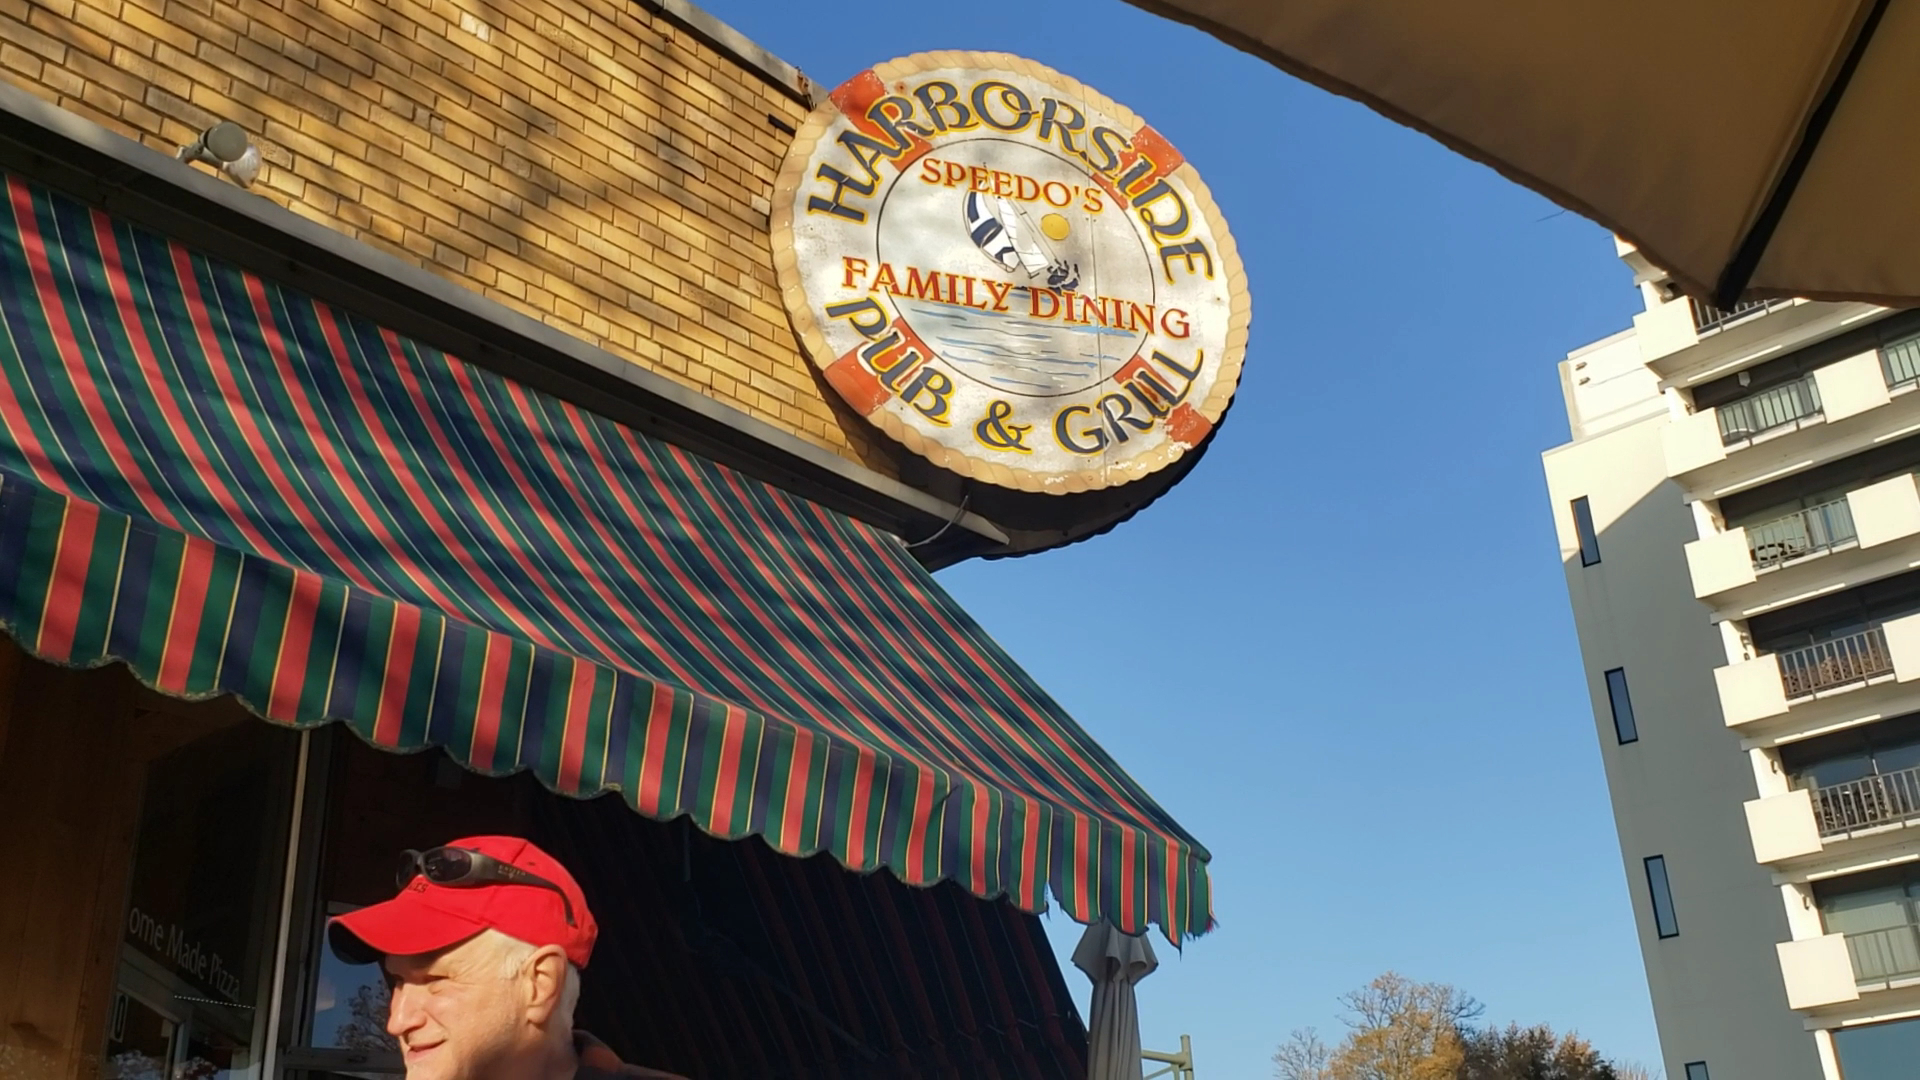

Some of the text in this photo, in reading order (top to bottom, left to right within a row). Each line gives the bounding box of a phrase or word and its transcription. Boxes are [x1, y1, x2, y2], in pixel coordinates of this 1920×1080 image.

[807, 80, 1214, 285] HARBORSIDE
[920, 158, 1104, 213] SPEEDO'S
[842, 256, 1191, 339] FAMILY DINING
[825, 296, 1205, 456] PUB & GRILL
[128, 907, 240, 1003] ome Made Pizza
